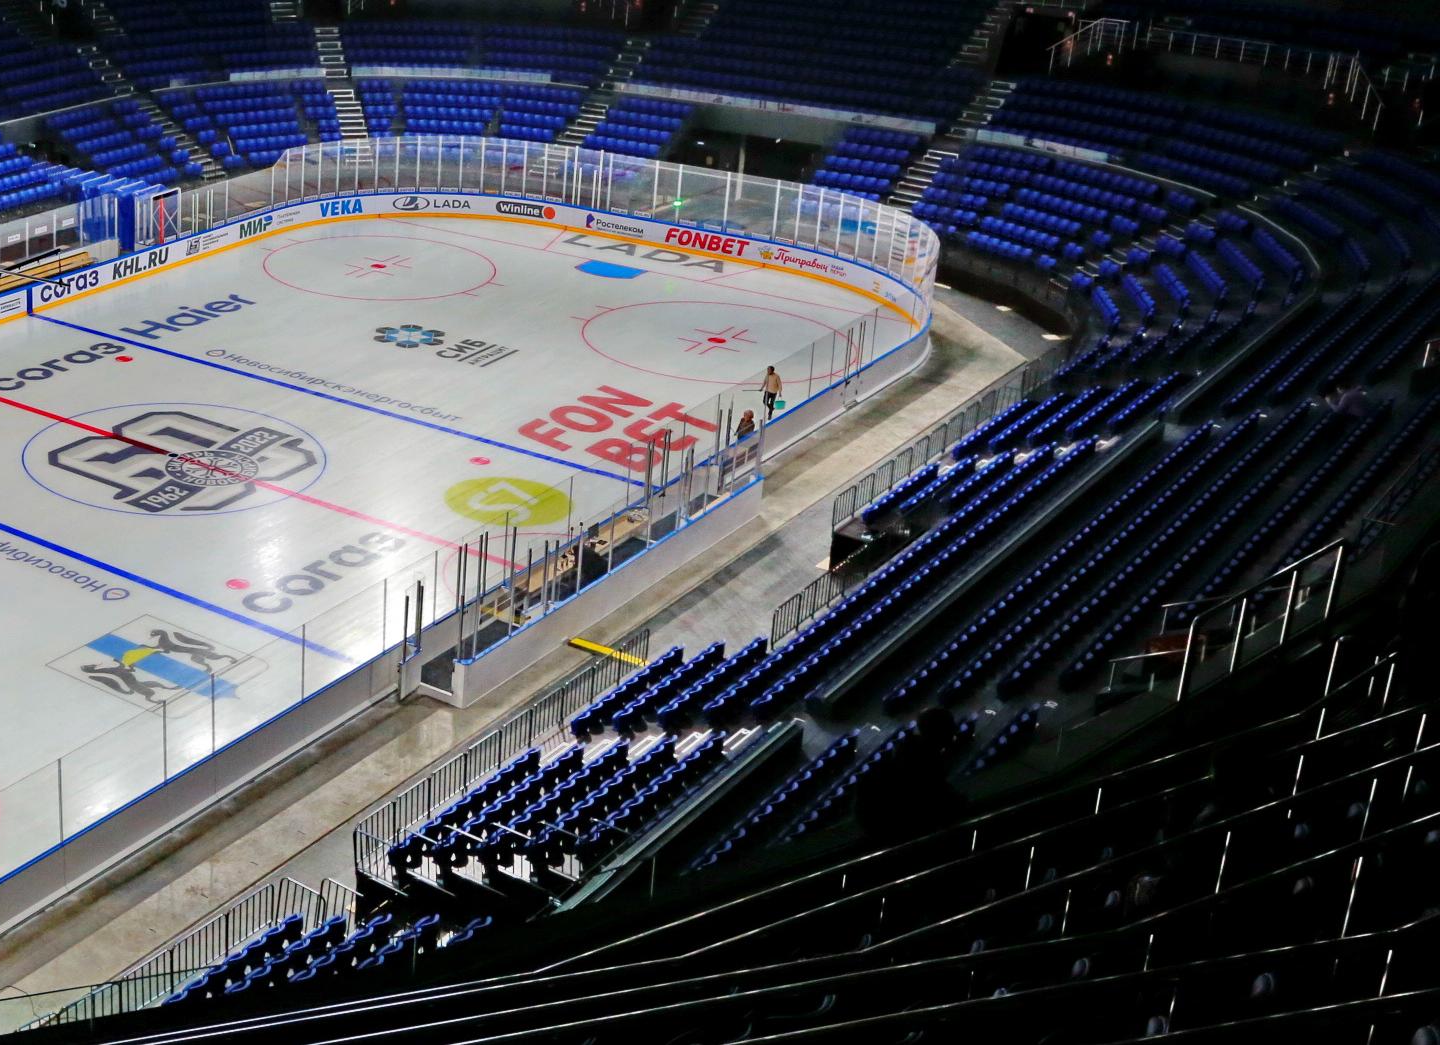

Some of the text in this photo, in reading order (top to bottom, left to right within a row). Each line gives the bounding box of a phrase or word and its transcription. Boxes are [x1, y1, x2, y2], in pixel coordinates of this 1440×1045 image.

[320, 199, 363, 217] VEKA
[433, 199, 471, 210] LADA
[499, 201, 541, 217] Winline
[240, 214, 273, 239] МИР
[595, 218, 644, 235] Ростелеком
[562, 234, 723, 273] LADA
[664, 227, 750, 257] FONBET
[112, 246, 169, 281] KHL.RU
[773, 247, 829, 274] Приправыч
[119, 293, 257, 339] Haier
[436, 338, 487, 360] СИБ
[517, 385, 654, 451] FON
[231, 430, 279, 454] 2022
[583, 402, 720, 472] BET
[139, 484, 190, 509] 1962
